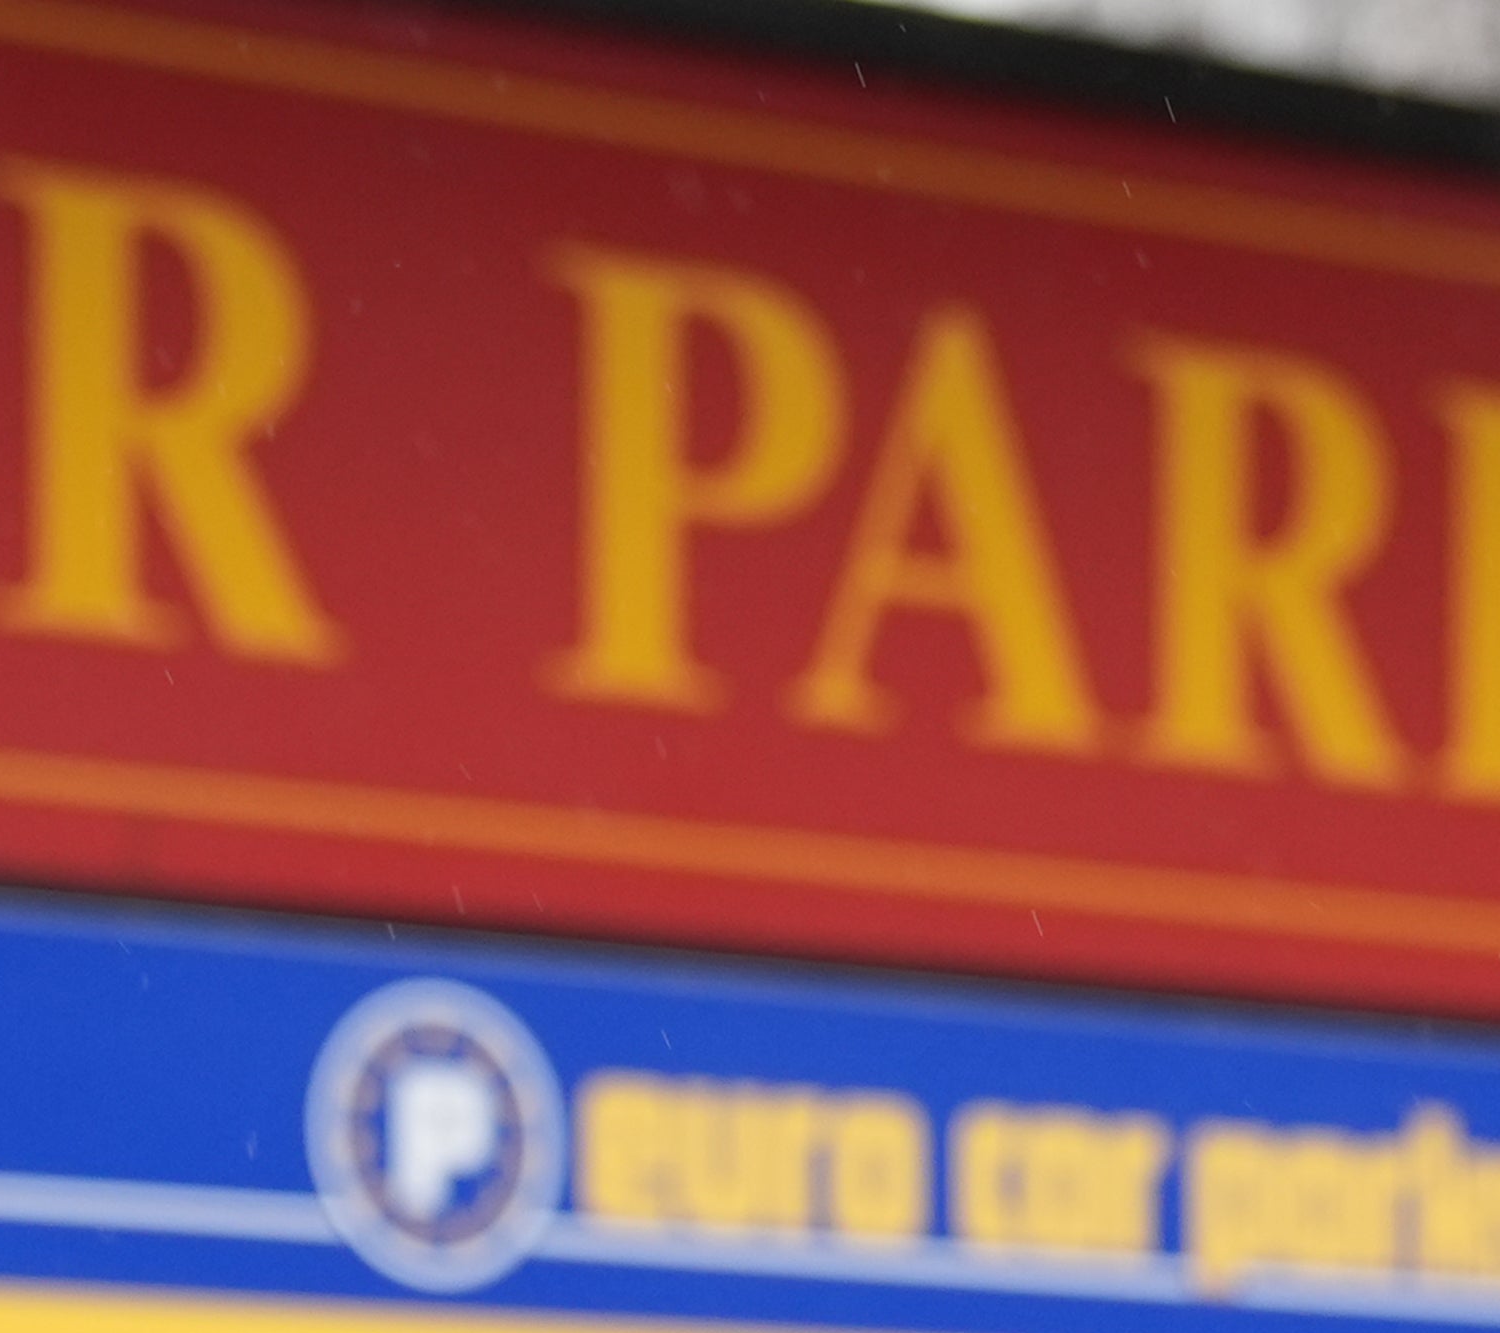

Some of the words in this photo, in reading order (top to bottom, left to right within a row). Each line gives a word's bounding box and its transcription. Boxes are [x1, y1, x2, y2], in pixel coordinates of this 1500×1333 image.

[384, 1056, 496, 1216] P
[574, 1070, 930, 1248] euro
[948, 1099, 1172, 1262] car
